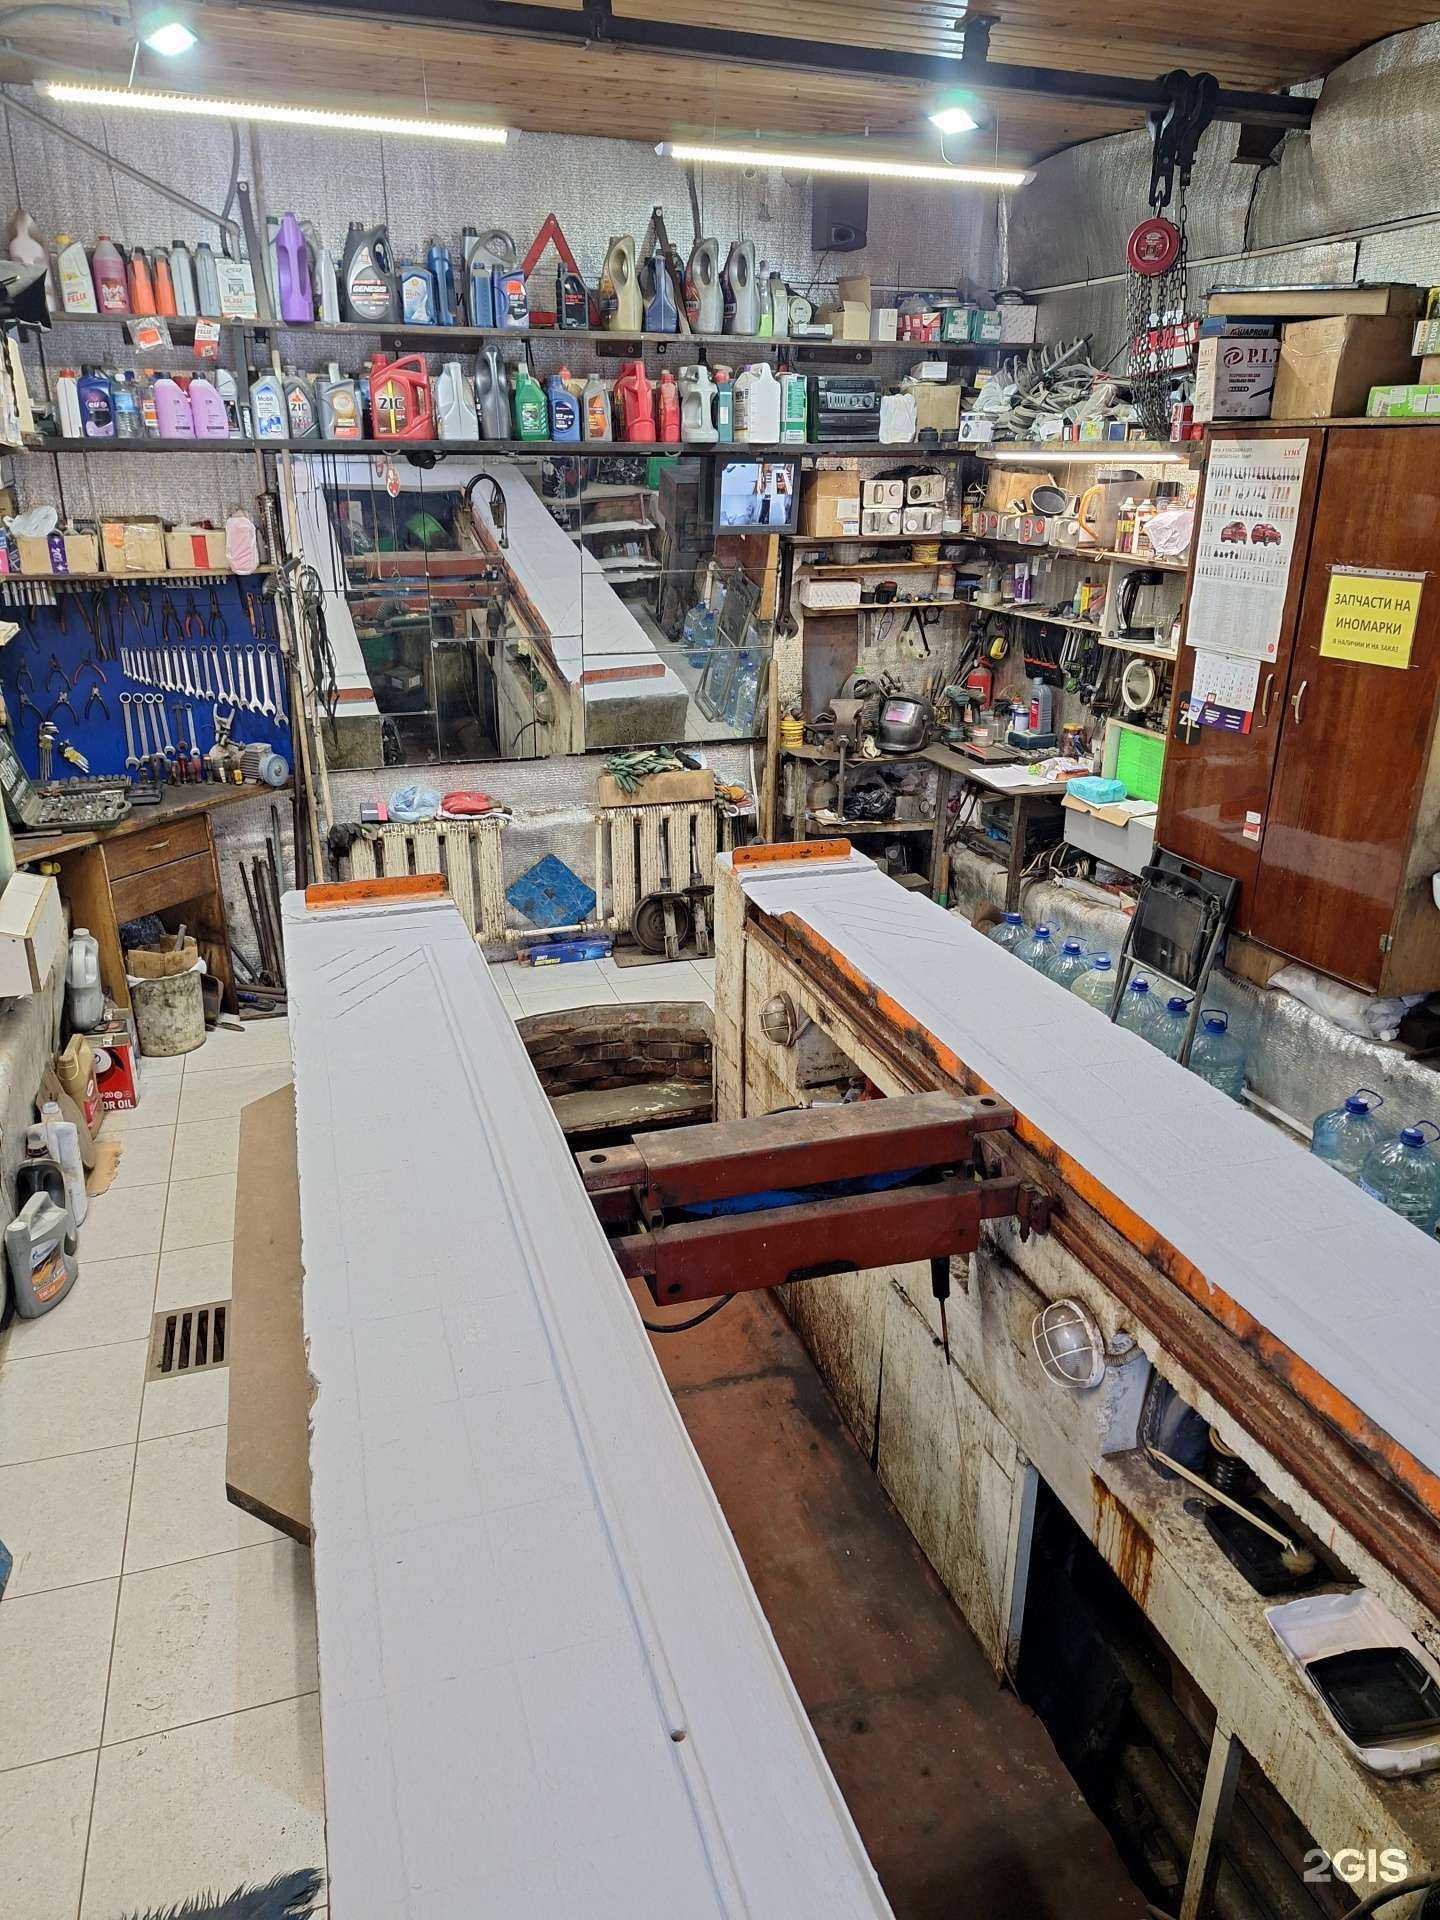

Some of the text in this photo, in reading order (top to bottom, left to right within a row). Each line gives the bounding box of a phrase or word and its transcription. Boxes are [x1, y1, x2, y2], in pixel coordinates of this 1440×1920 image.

[291, 403, 307, 411] ZIC
[378, 397, 405, 410] ZIC
[1334, 593, 1411, 612] ЗАПЧАСТИ НА
[1335, 617, 1402, 636] ИНОМАРКИ
[117, 1099, 135, 1109] OIL
